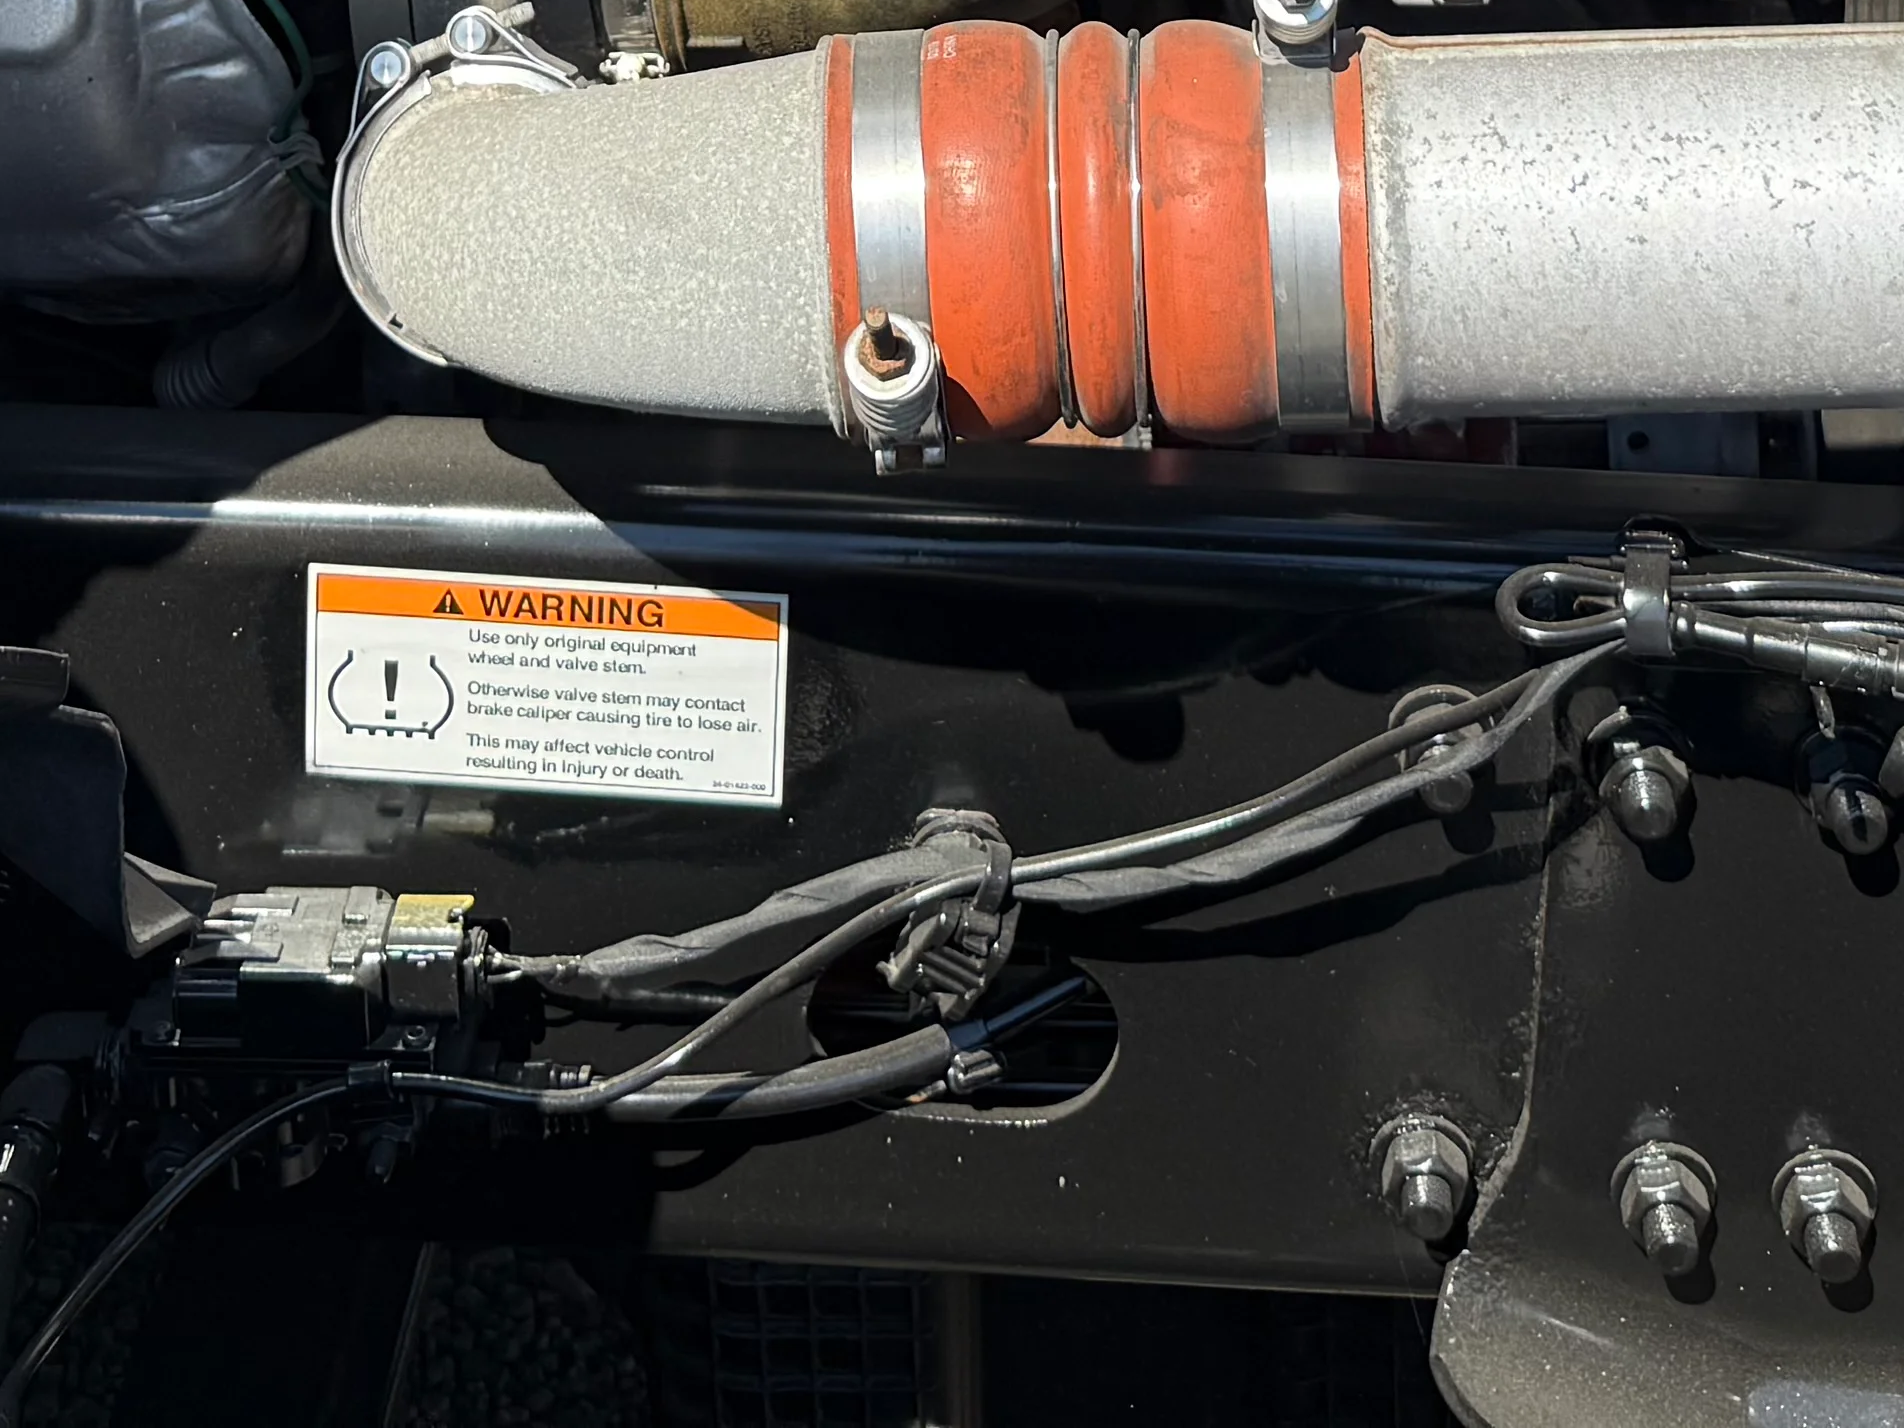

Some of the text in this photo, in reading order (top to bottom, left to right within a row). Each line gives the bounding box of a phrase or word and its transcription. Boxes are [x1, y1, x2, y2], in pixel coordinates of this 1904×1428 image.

[479, 588, 665, 628] WARNING
[468, 628, 698, 659] Use only original equipment
[467, 650, 647, 676] wheel and valve stem.
[467, 679, 747, 714] Otherwise valve stem may contact
[466, 699, 763, 734] brake caliper causing tire to lose air.
[465, 733, 716, 763] This may affect vehicle control
[465, 753, 537, 775] resulting
[611, 765, 630, 779] or
[634, 762, 684, 782] death.
